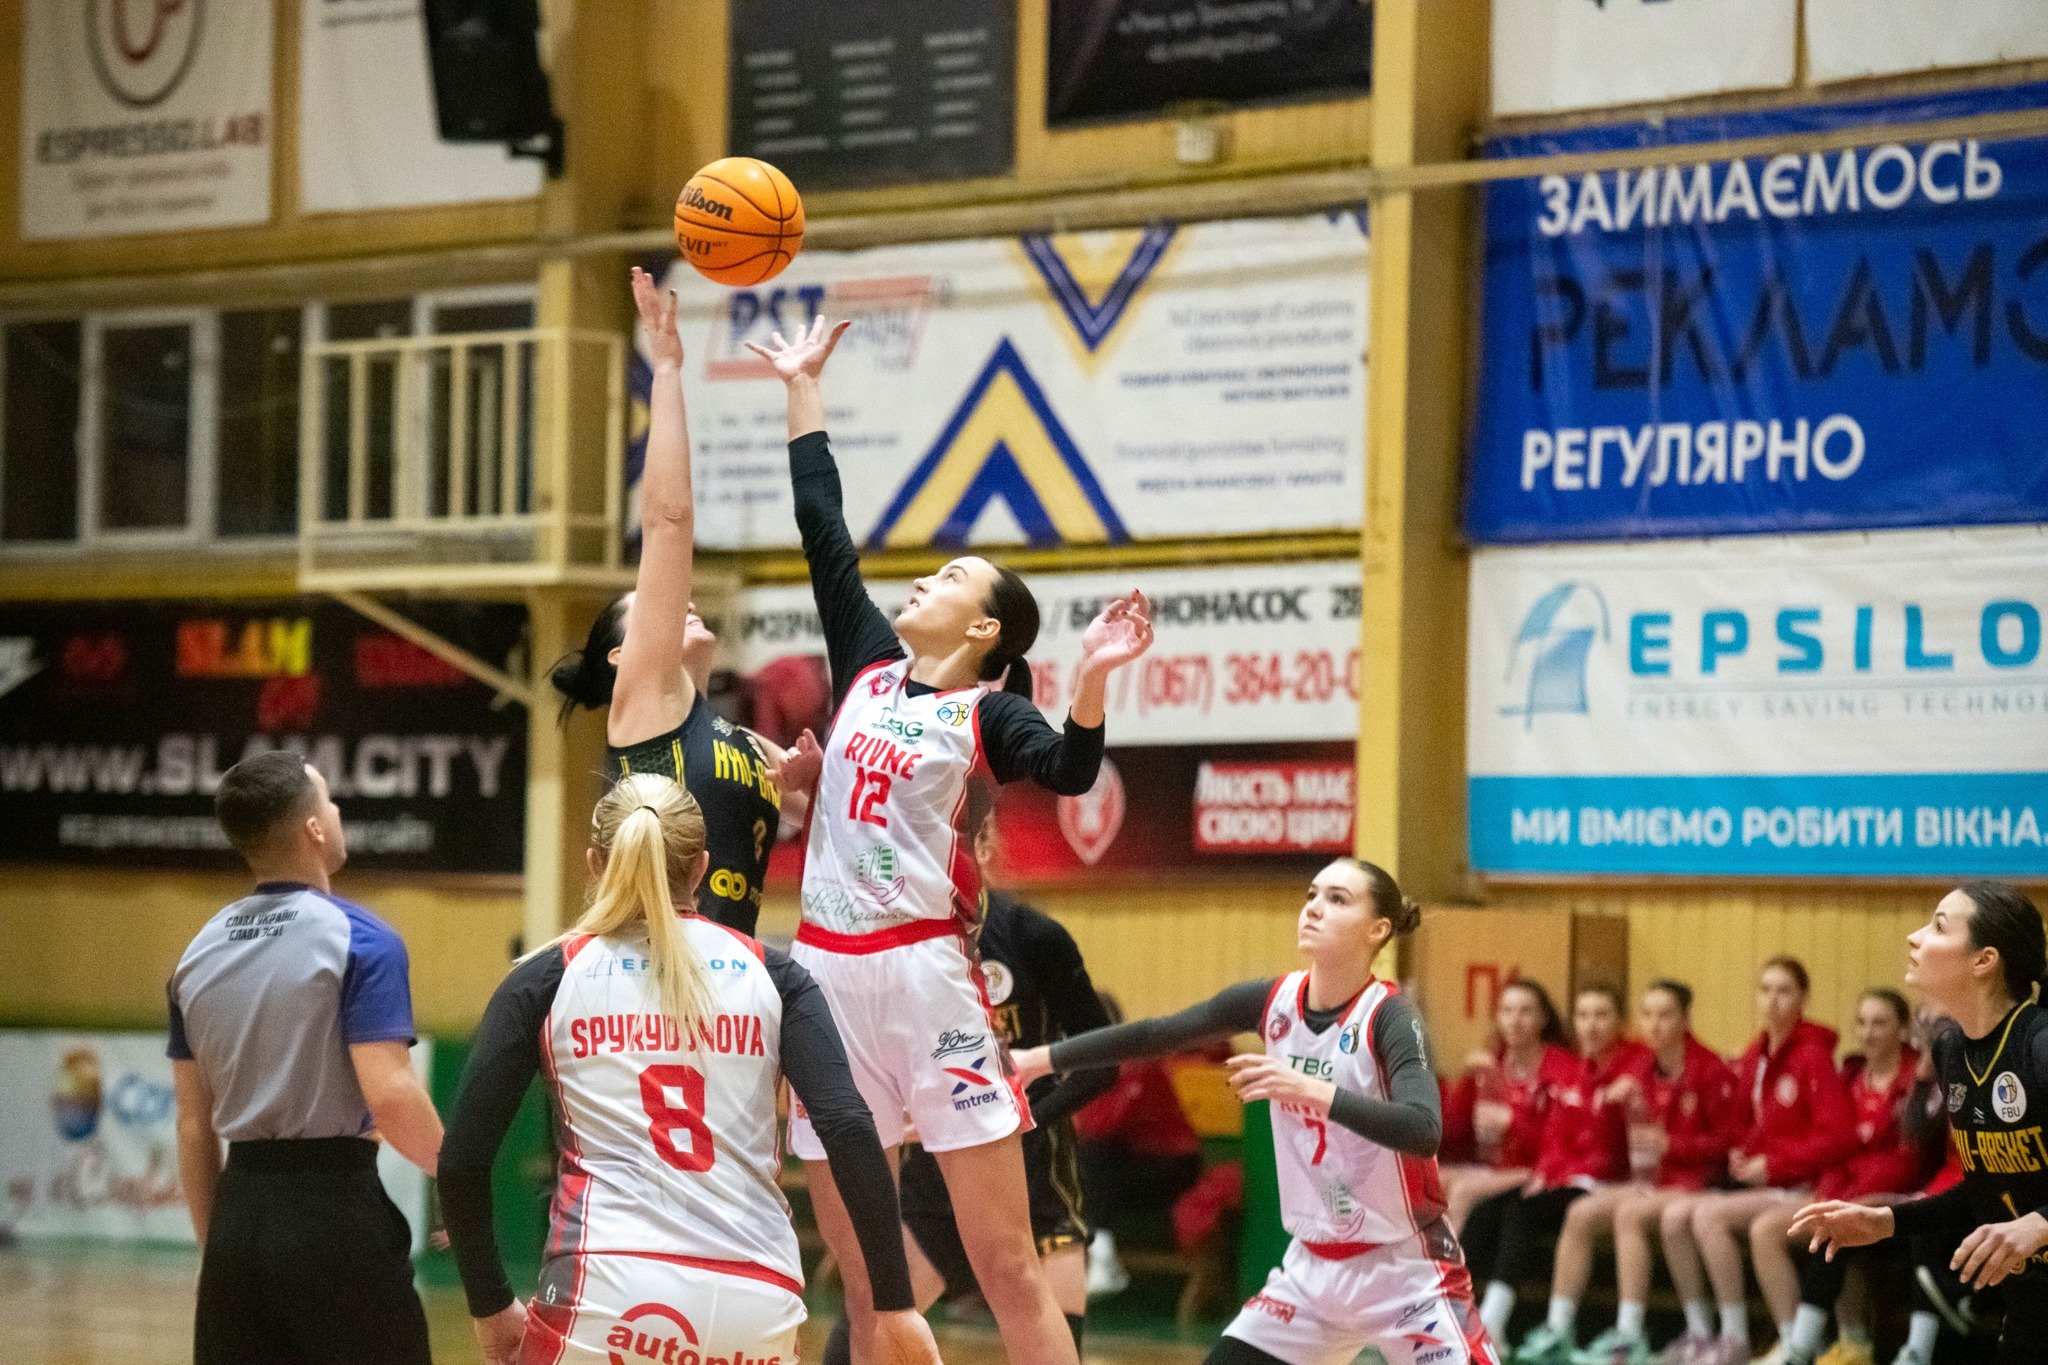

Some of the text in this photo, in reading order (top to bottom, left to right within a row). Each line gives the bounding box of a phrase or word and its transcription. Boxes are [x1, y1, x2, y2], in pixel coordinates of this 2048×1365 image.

[1522, 414, 1866, 491] РЕГУЛЯРНО
[1629, 599, 2041, 675] EPSILO
[844, 731, 922, 781] RIVNE
[848, 766, 891, 828] 12
[1511, 806, 1571, 845] МИ
[1578, 806, 1732, 847] ВМІЄМО
[1741, 805, 1903, 847] РОБИТИ
[638, 1064, 716, 1173] 8
[952, 1090, 999, 1111] imtrex
[2001, 1106, 2021, 1118] FBU
[1304, 1117, 1327, 1166] 7
